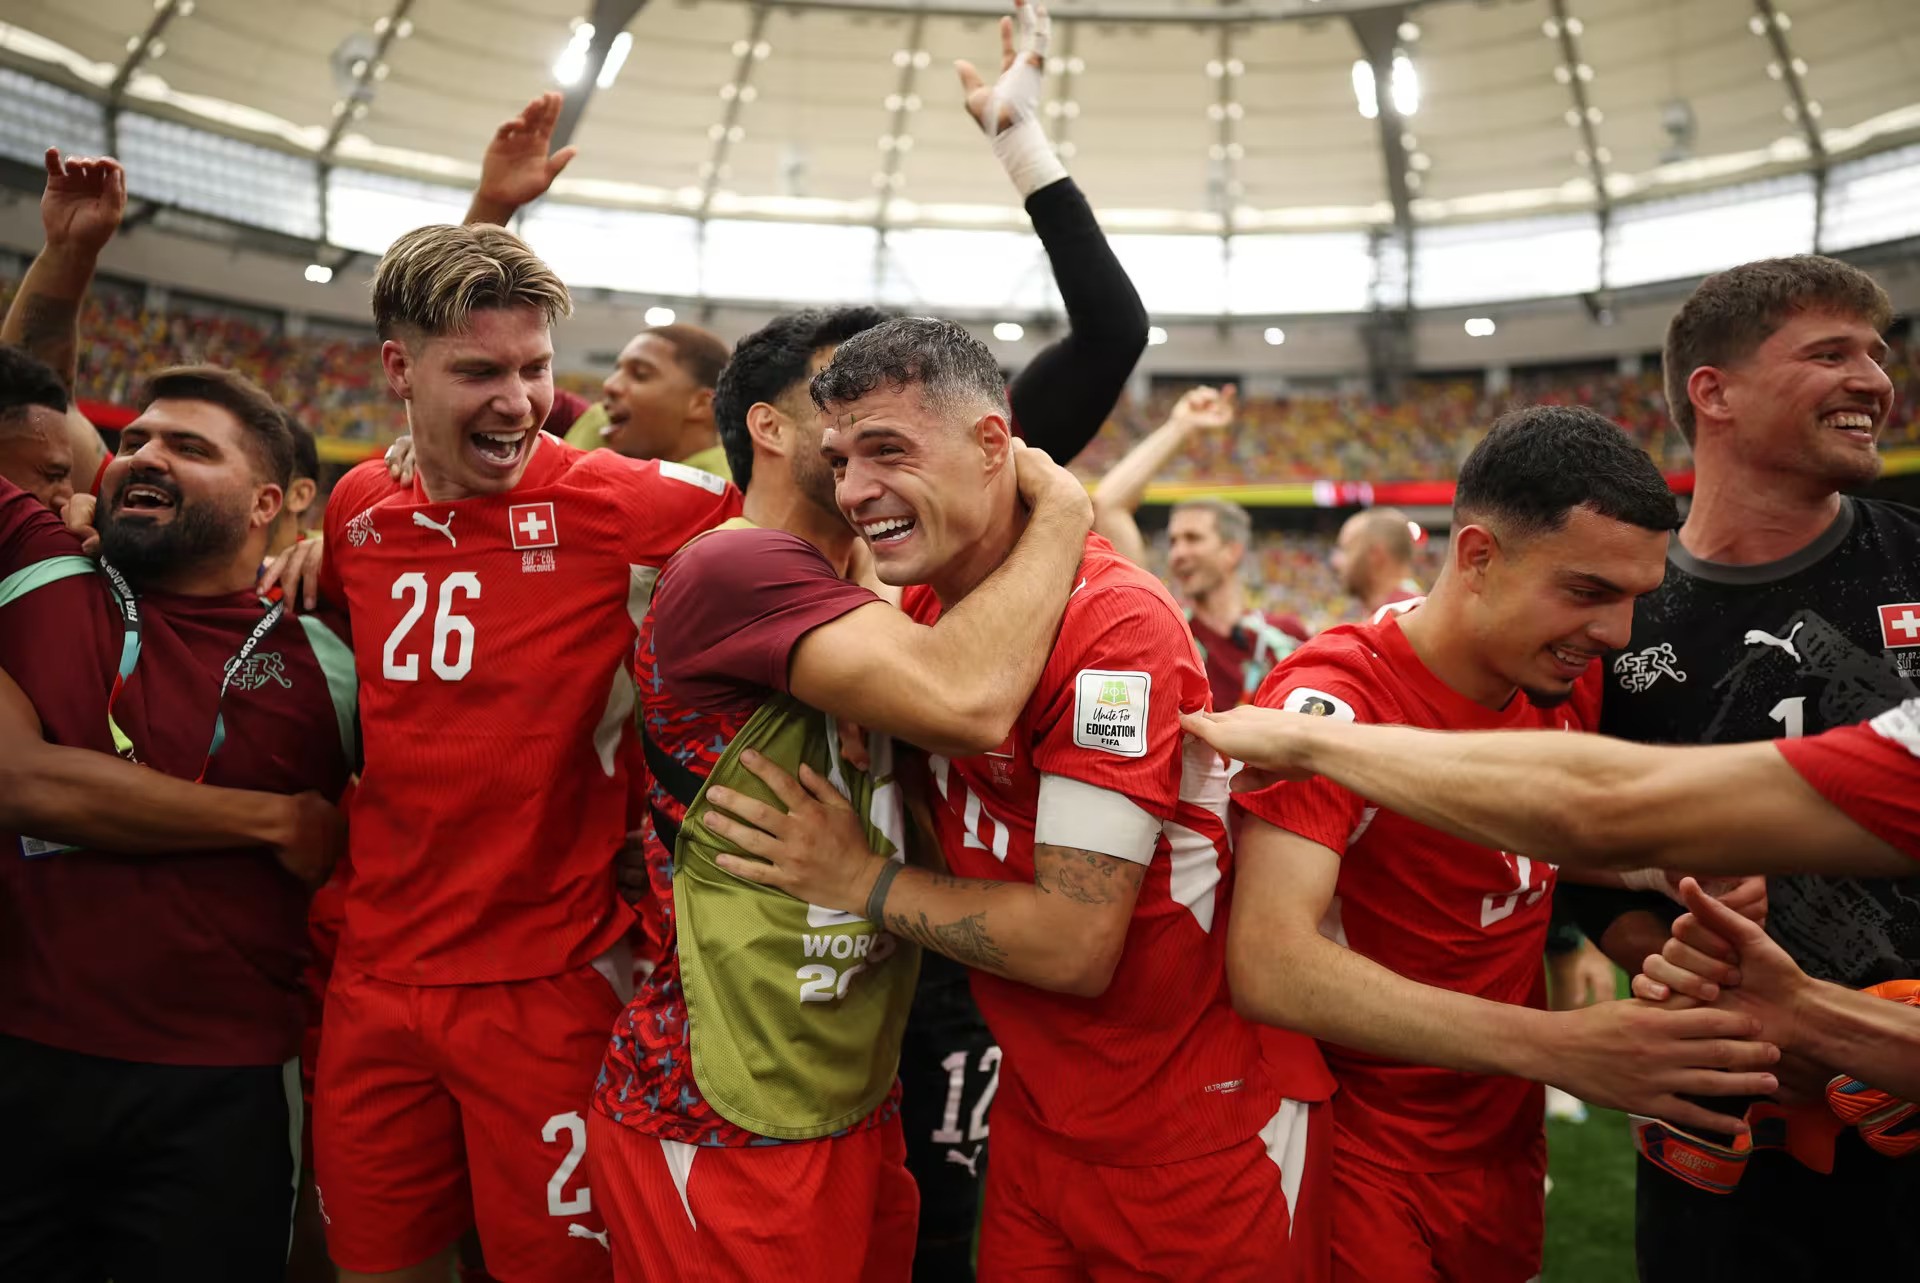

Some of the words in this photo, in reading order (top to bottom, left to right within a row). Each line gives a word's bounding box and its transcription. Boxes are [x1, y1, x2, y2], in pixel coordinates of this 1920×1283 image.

[125, 600, 138, 622] FIFA
[252, 601, 284, 638] WORLD
[383, 571, 482, 682] 26
[240, 637, 258, 659] CUP
[1896, 659, 1912, 670] SUI
[1093, 706, 1117, 723] Unite
[1118, 708, 1131, 723] For
[1085, 722, 1136, 738] EDUCATION
[1101, 738, 1120, 747] FIFA
[932, 1045, 1003, 1143] 12
[541, 1110, 592, 1217] 2
